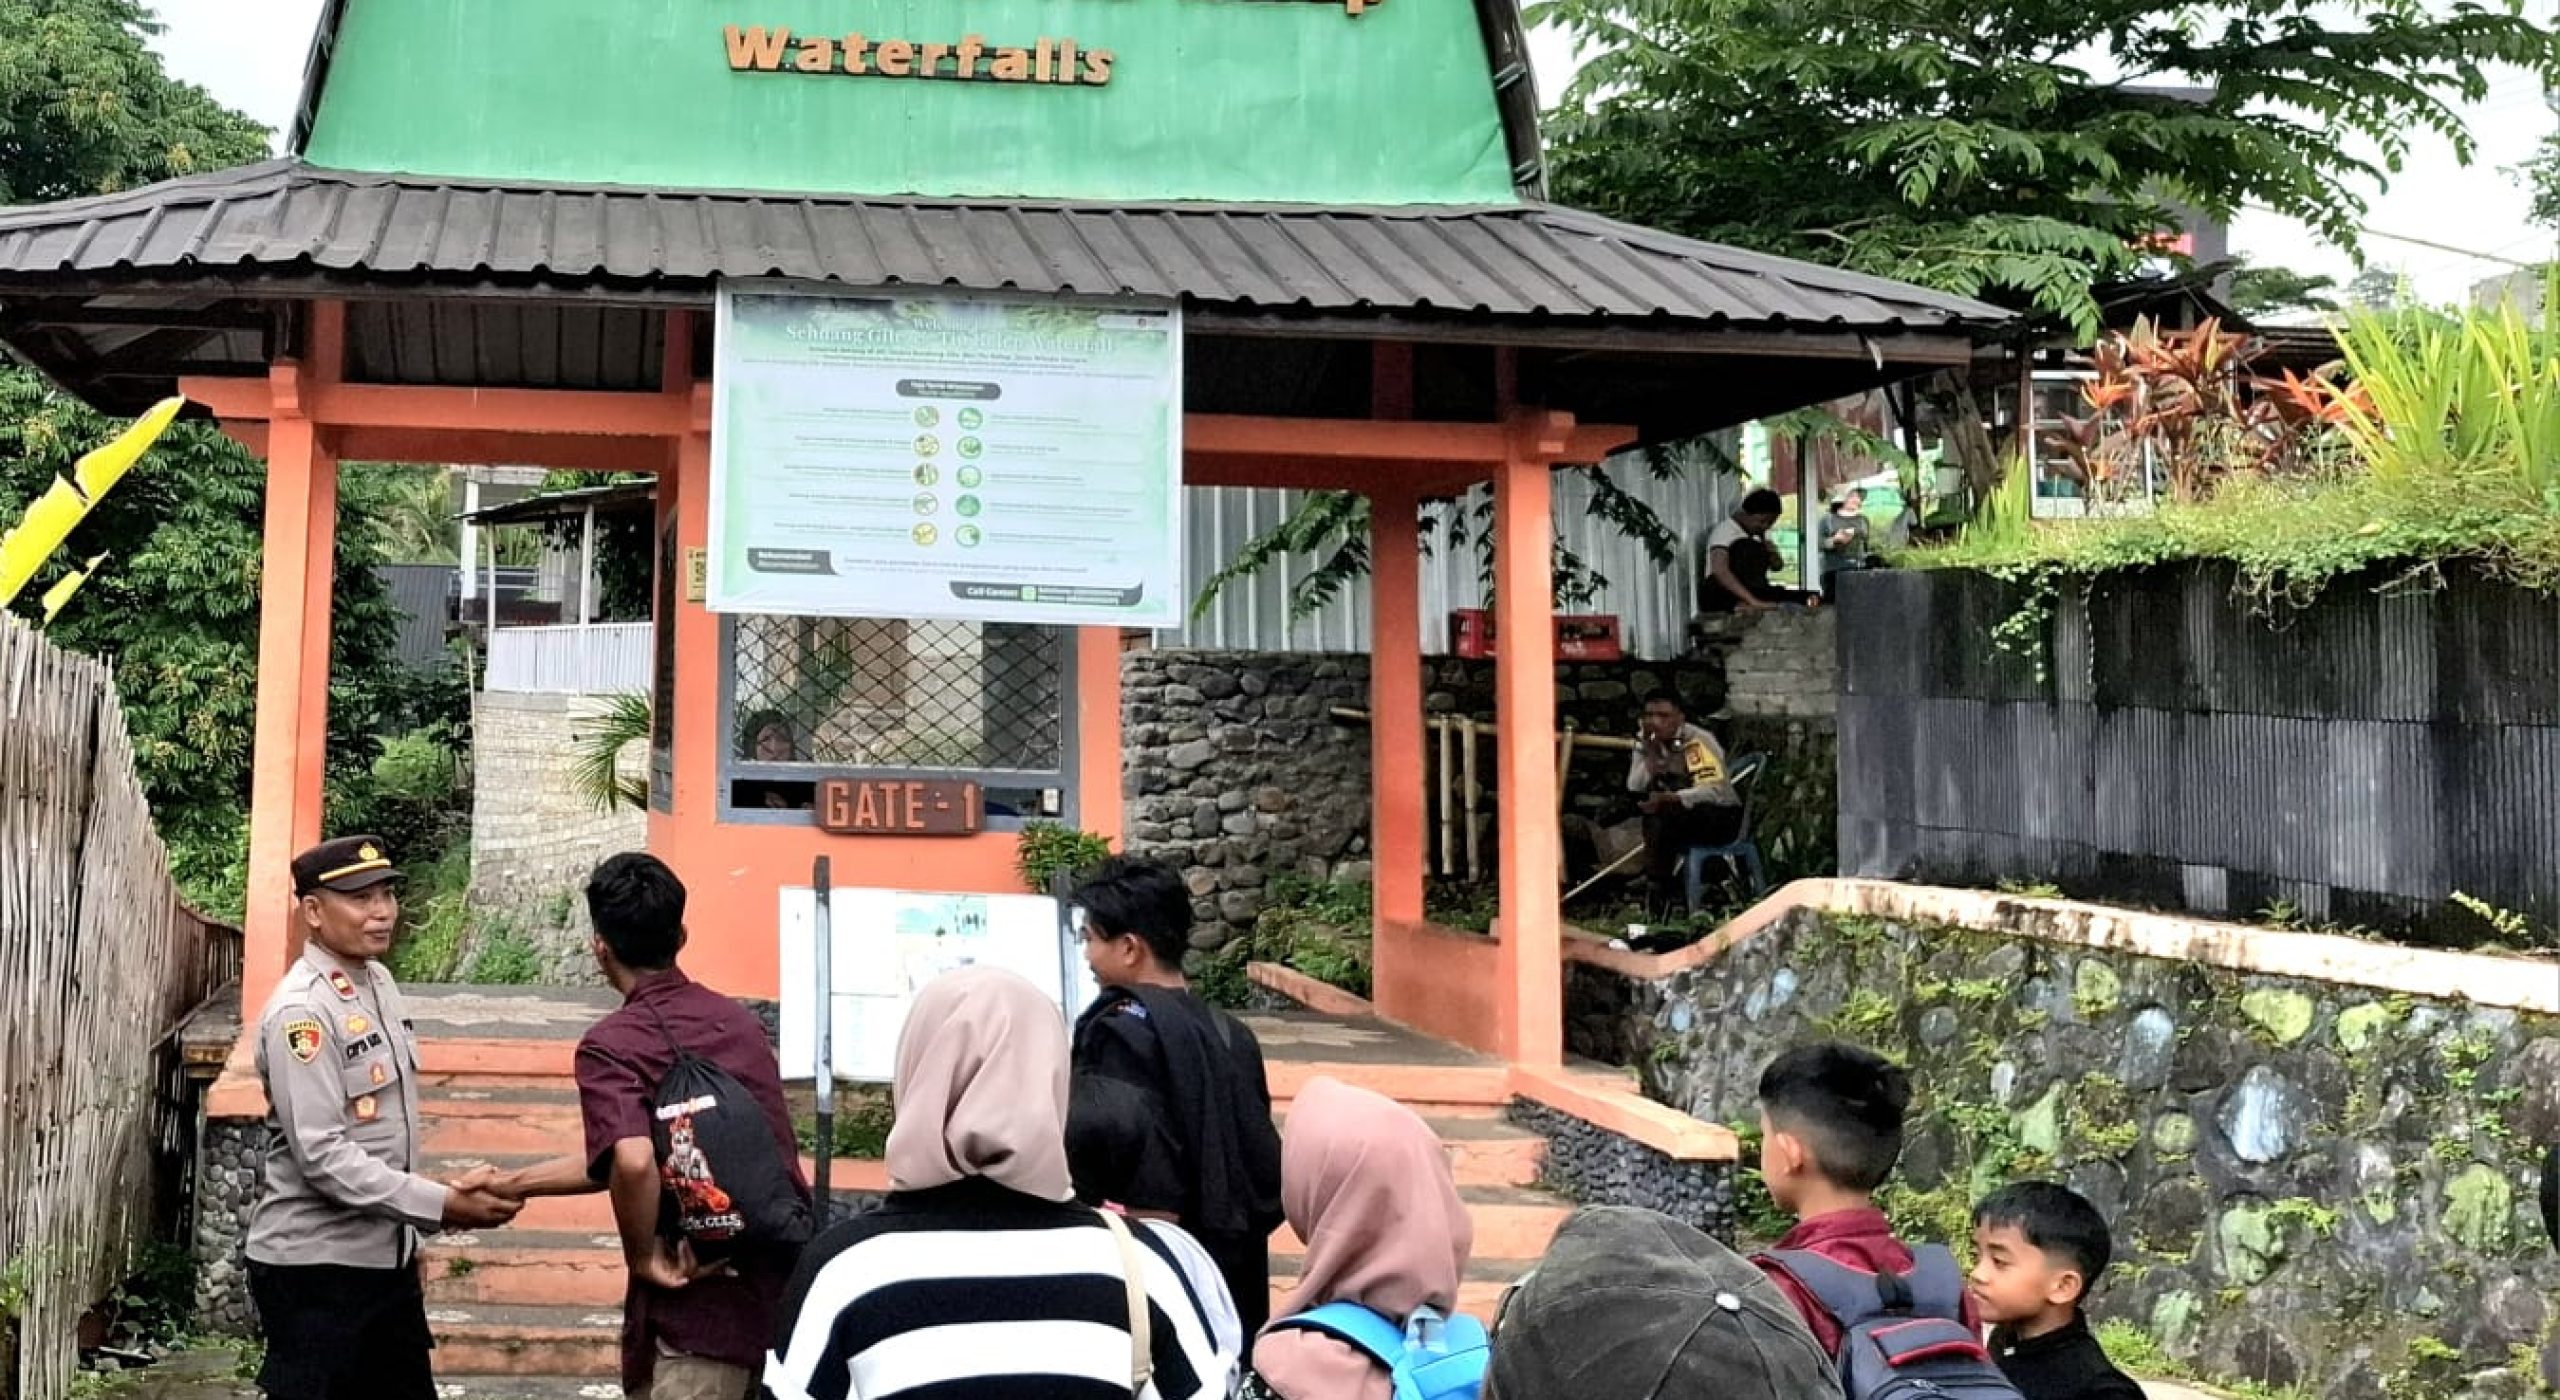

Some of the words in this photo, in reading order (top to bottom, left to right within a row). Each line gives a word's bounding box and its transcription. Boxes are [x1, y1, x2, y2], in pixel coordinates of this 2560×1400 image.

[723, 24, 1112, 85] Waterfalls
[825, 781, 926, 828] GATE
[963, 783, 976, 830] 1
